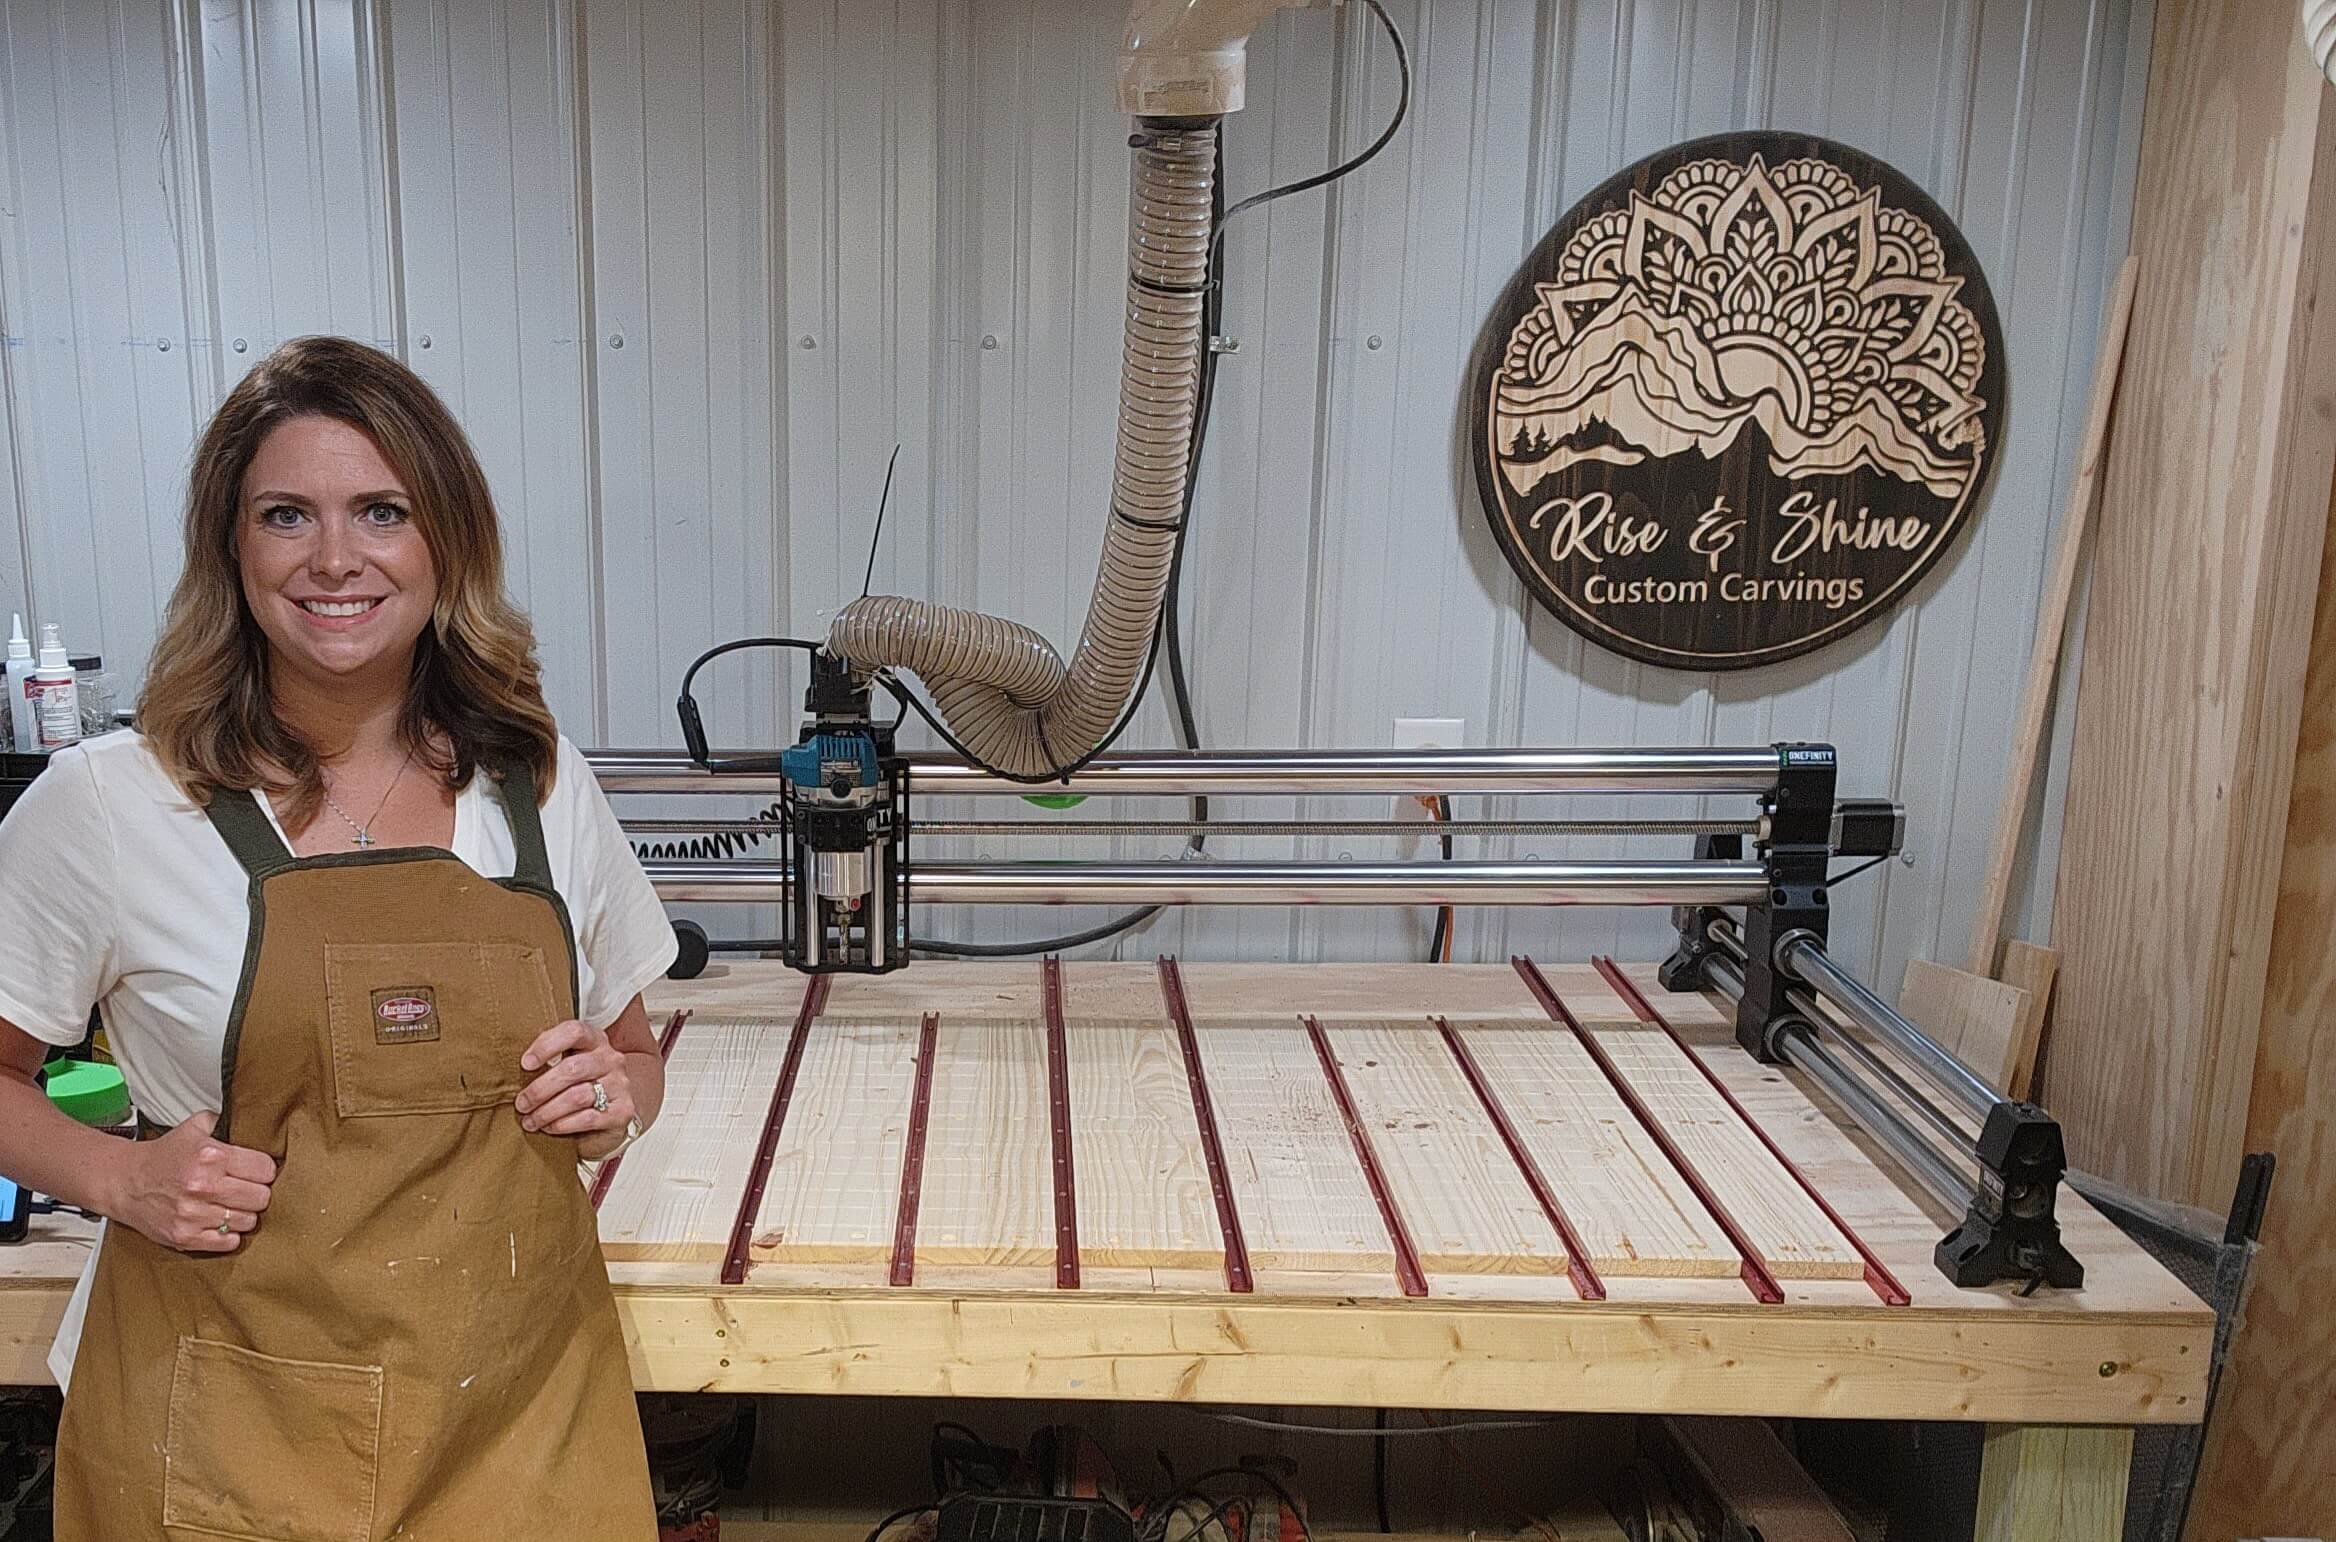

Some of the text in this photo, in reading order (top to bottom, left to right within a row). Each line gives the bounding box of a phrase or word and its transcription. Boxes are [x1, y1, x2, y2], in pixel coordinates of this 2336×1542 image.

[1529, 490, 1931, 573] Rise & Shine
[1584, 571, 1865, 609] Custom Carvings
